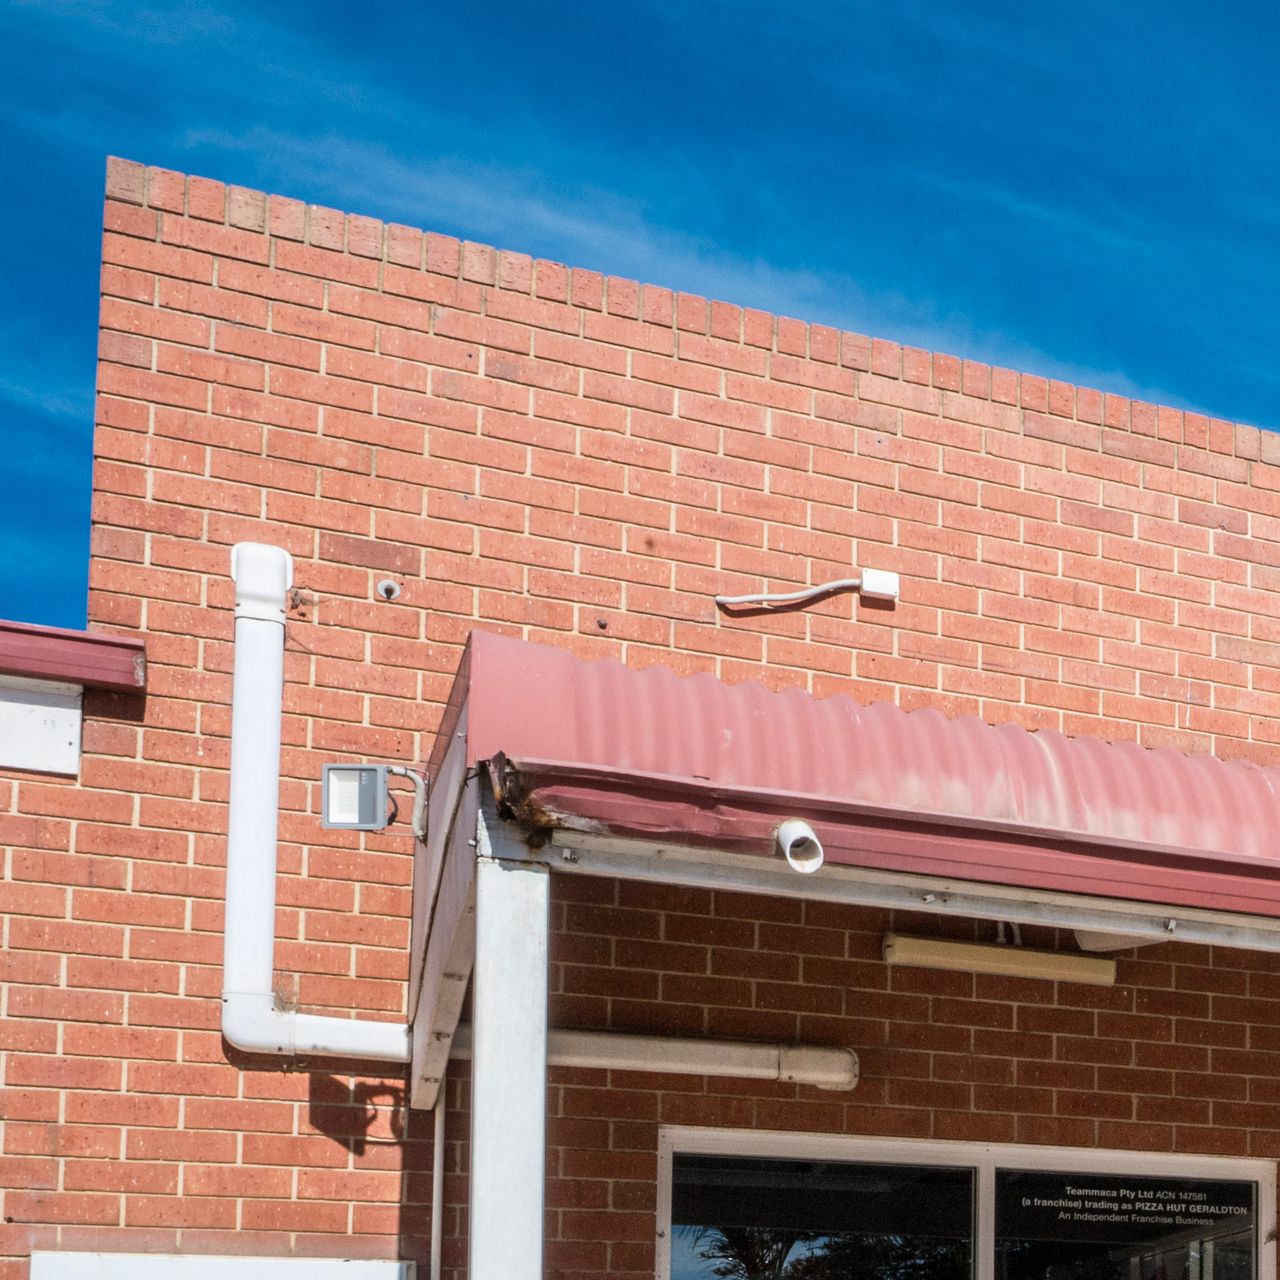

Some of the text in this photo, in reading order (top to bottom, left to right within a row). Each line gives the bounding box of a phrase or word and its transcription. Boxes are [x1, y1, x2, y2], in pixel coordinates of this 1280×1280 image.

[1065, 1186, 1117, 1197] Teammaca
[1119, 1188, 1136, 1199] Pty
[1138, 1189, 1154, 1199] Ltd
[1155, 1190, 1175, 1200] ACN
[1022, 1197, 1248, 1215] (a franchise) trading as PIZZA HUT GERALDTON
[1058, 1211, 1214, 1225] An Independent Franchise Business
